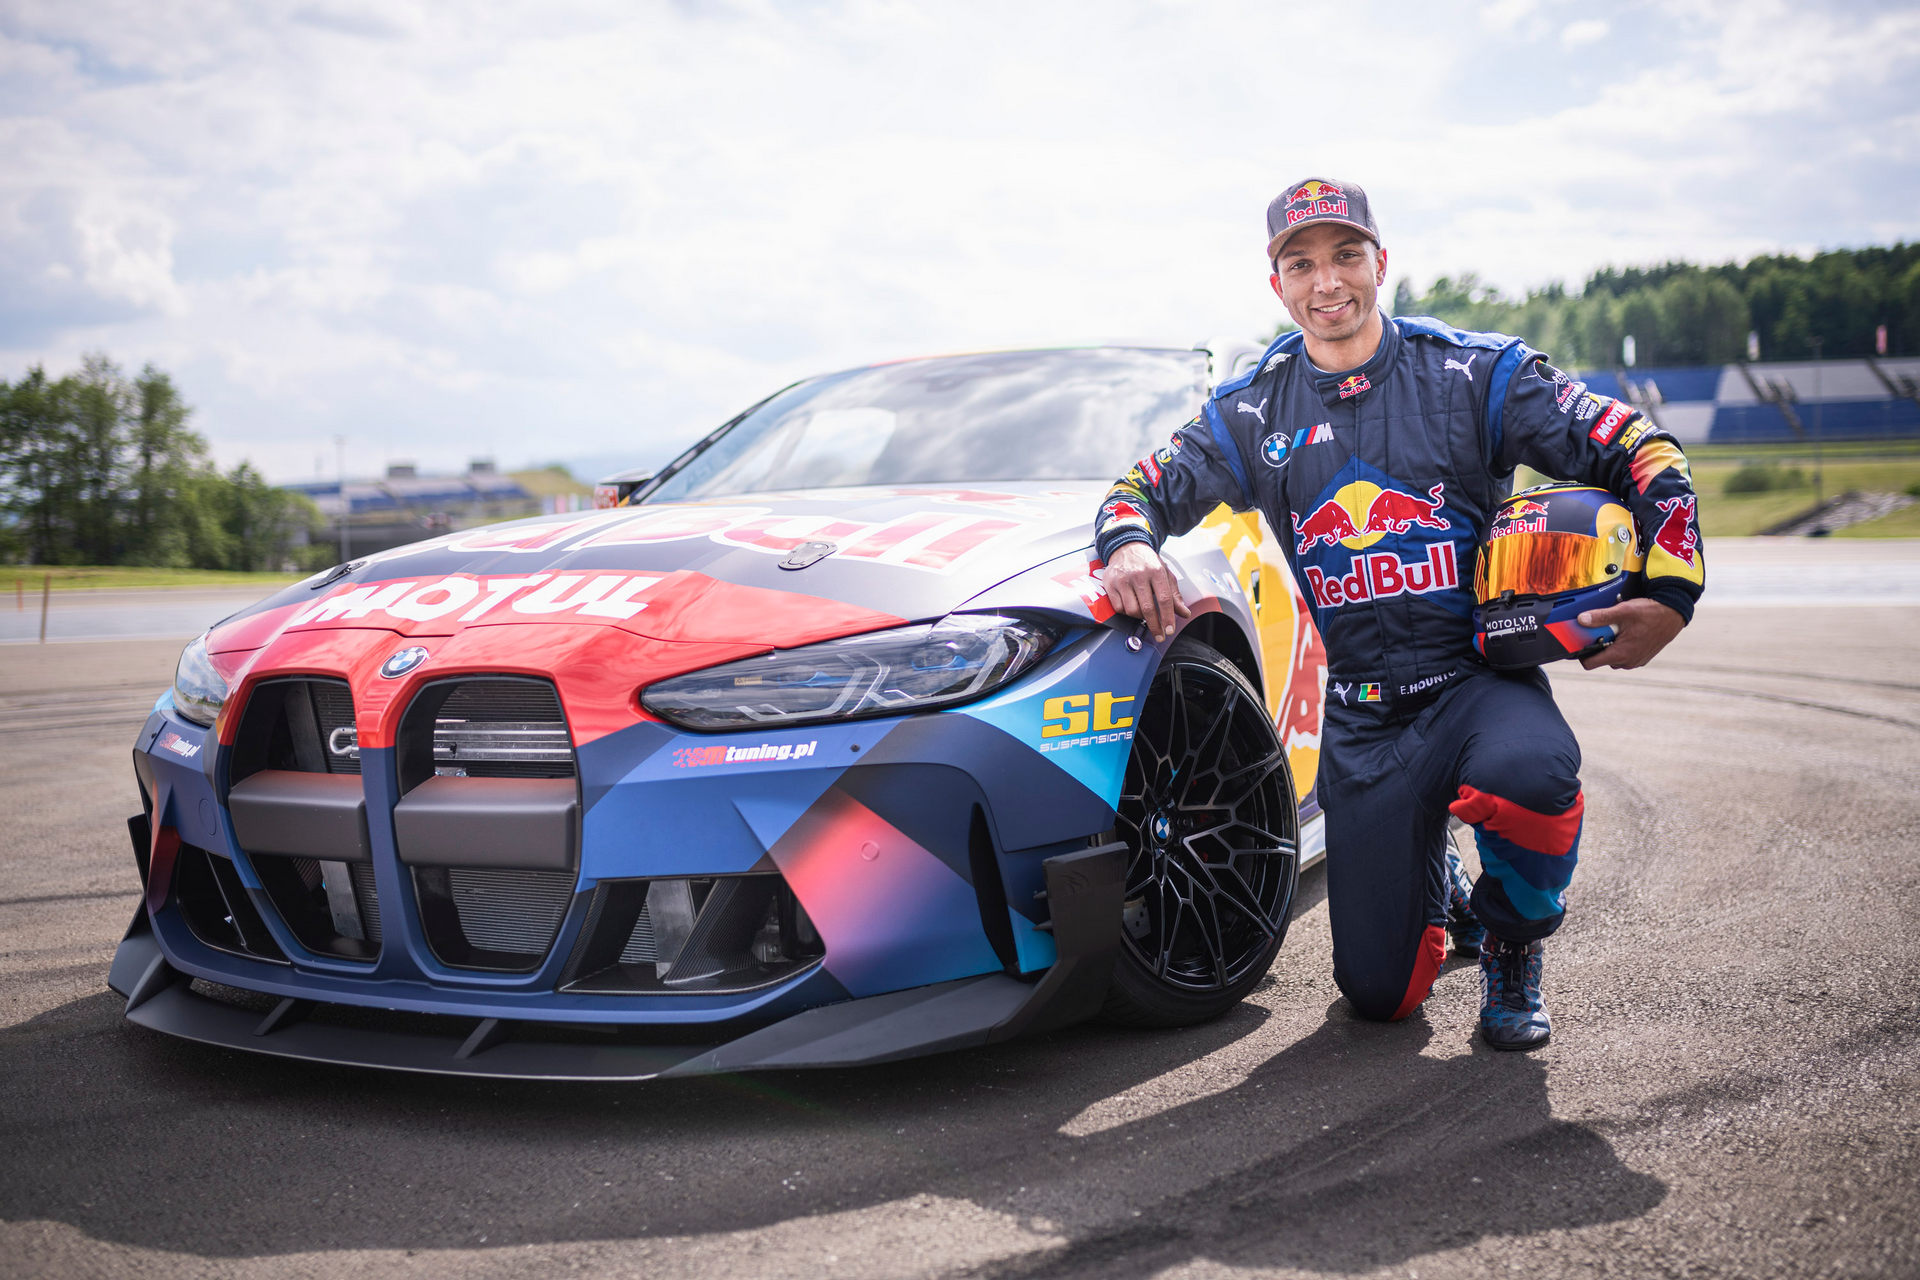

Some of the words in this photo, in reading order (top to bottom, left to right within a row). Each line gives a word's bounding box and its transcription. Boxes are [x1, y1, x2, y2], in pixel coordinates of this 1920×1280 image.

[1286, 200, 1317, 226] Red
[1317, 200, 1348, 216] Bull
[1340, 387, 1356, 399] Red
[1355, 380, 1371, 394] Bull
[1596, 401, 1630, 440] MOTU
[562, 507, 1025, 575] Bull
[1490, 520, 1516, 541] Red
[1516, 517, 1547, 534] Bull
[1303, 555, 1371, 608] Red
[1367, 540, 1459, 599] Bull
[289, 572, 664, 627] MOTUL
